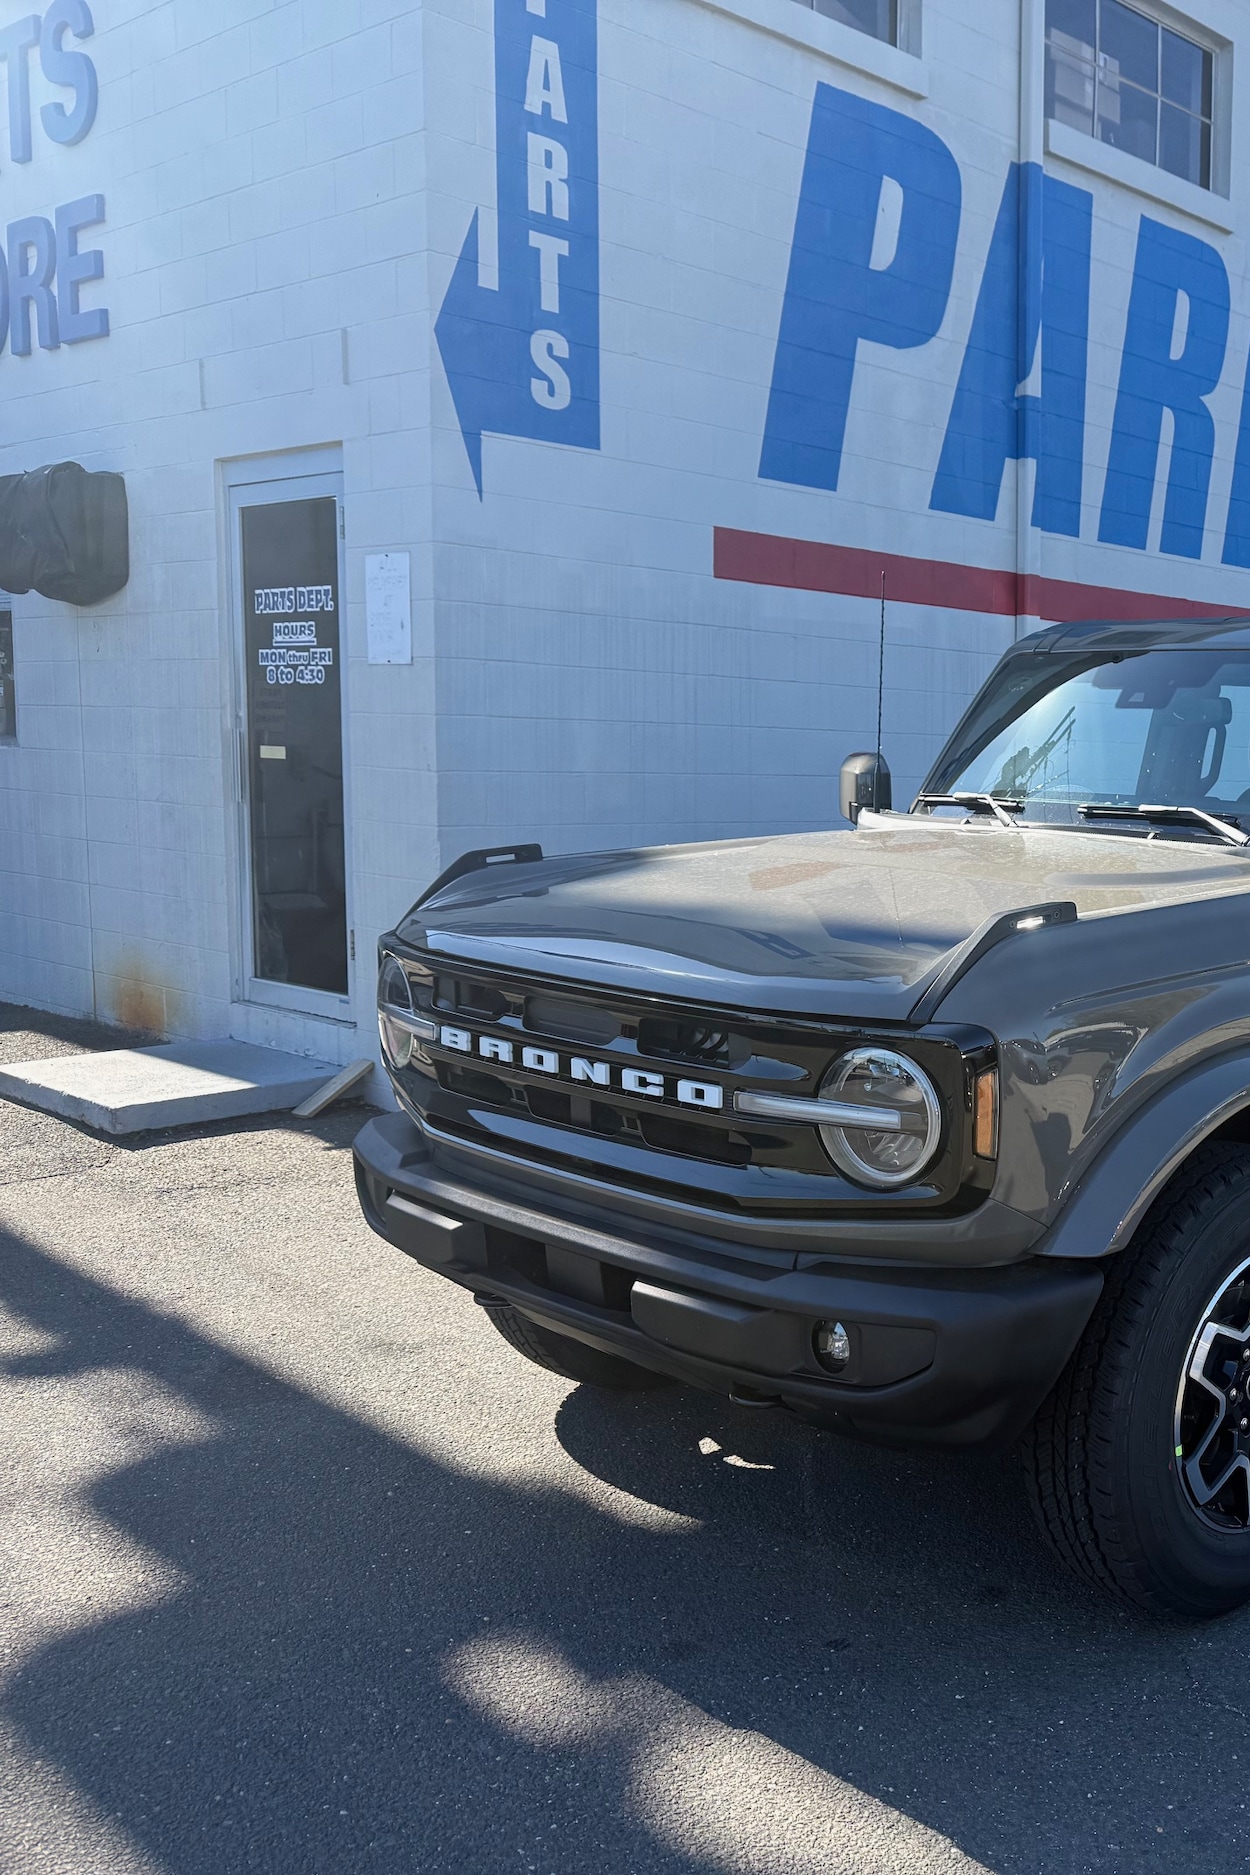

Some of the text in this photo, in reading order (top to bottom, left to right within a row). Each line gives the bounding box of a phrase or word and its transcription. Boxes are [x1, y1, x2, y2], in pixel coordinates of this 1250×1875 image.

[524, 0, 571, 411] ARTS
[255, 585, 334, 613] PARTS DEPT.
[273, 622, 315, 638] HOURS
[259, 648, 333, 665] MON thru FRI
[266, 666, 325, 683] 8 to 4:30
[440, 1025, 724, 1109] BRONCO
